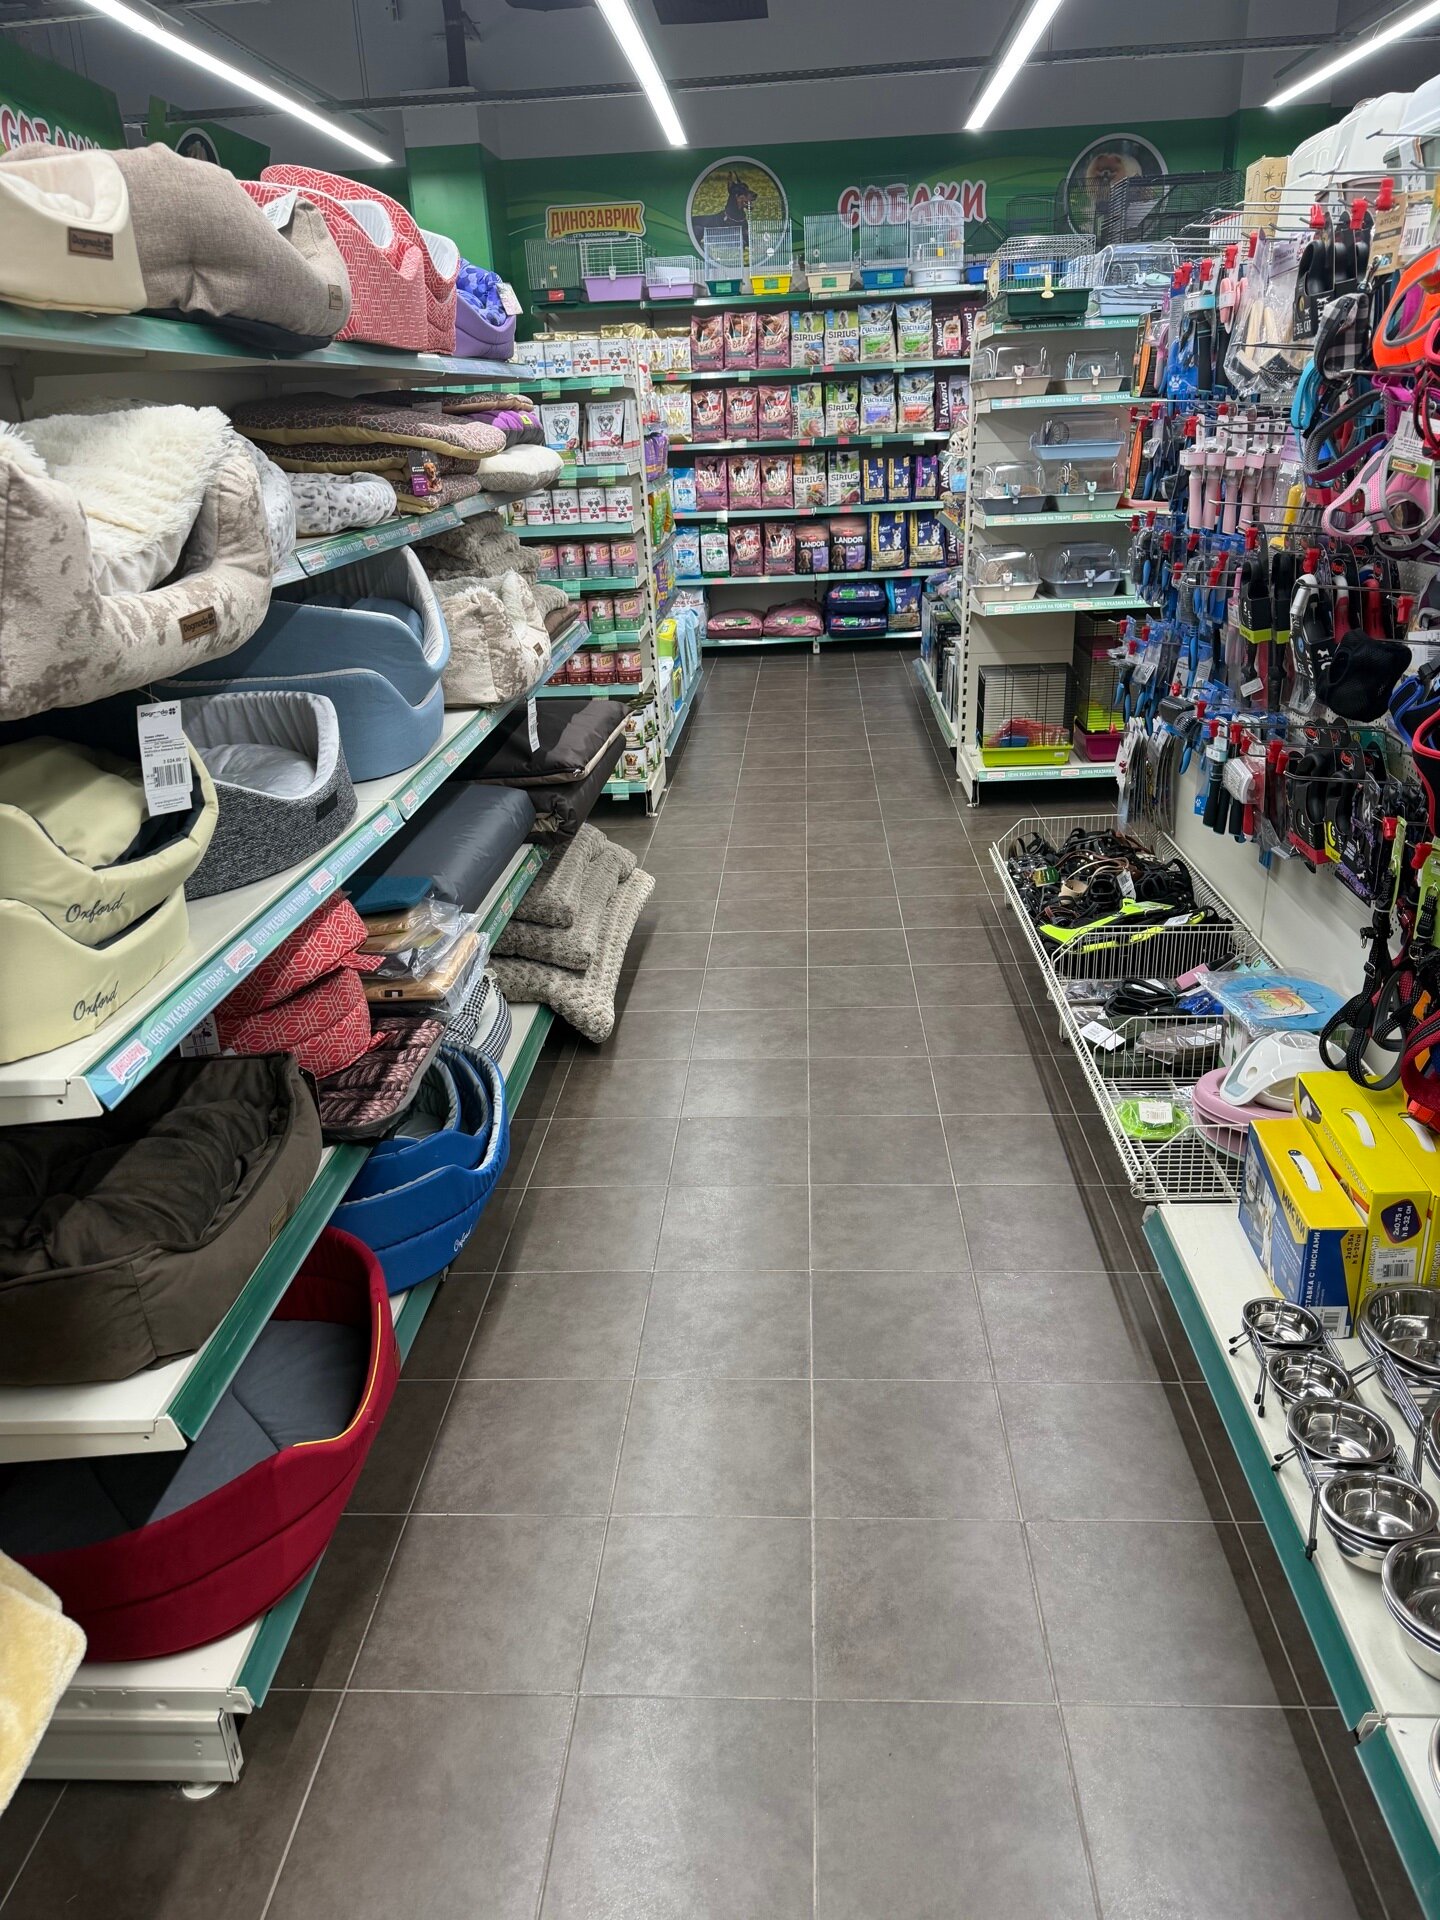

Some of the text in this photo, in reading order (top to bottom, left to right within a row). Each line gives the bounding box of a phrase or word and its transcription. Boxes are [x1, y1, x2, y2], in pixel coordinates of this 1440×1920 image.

[551, 207, 640, 237] ДИНОЗАВРИК
[793, 333, 823, 341] SIRIUS
[828, 330, 857, 339] SIRIUS
[936, 322, 944, 347] Award
[827, 403, 855, 411] SIRIUS
[939, 381, 949, 416] Award
[796, 474, 823, 485] SIRIUS
[831, 473, 859, 481] SIRIUS
[834, 536, 863, 544] LANDOR
[65, 891, 126, 923] Oxford
[73, 980, 119, 1021] Oxford
[147, 966, 231, 1046] ЦЕНА УКАЗАНА НА ТОВАРЕ
[1282, 1189, 1306, 1238] МИСКИ
[1309, 1232, 1321, 1271] МИСКАМИ
